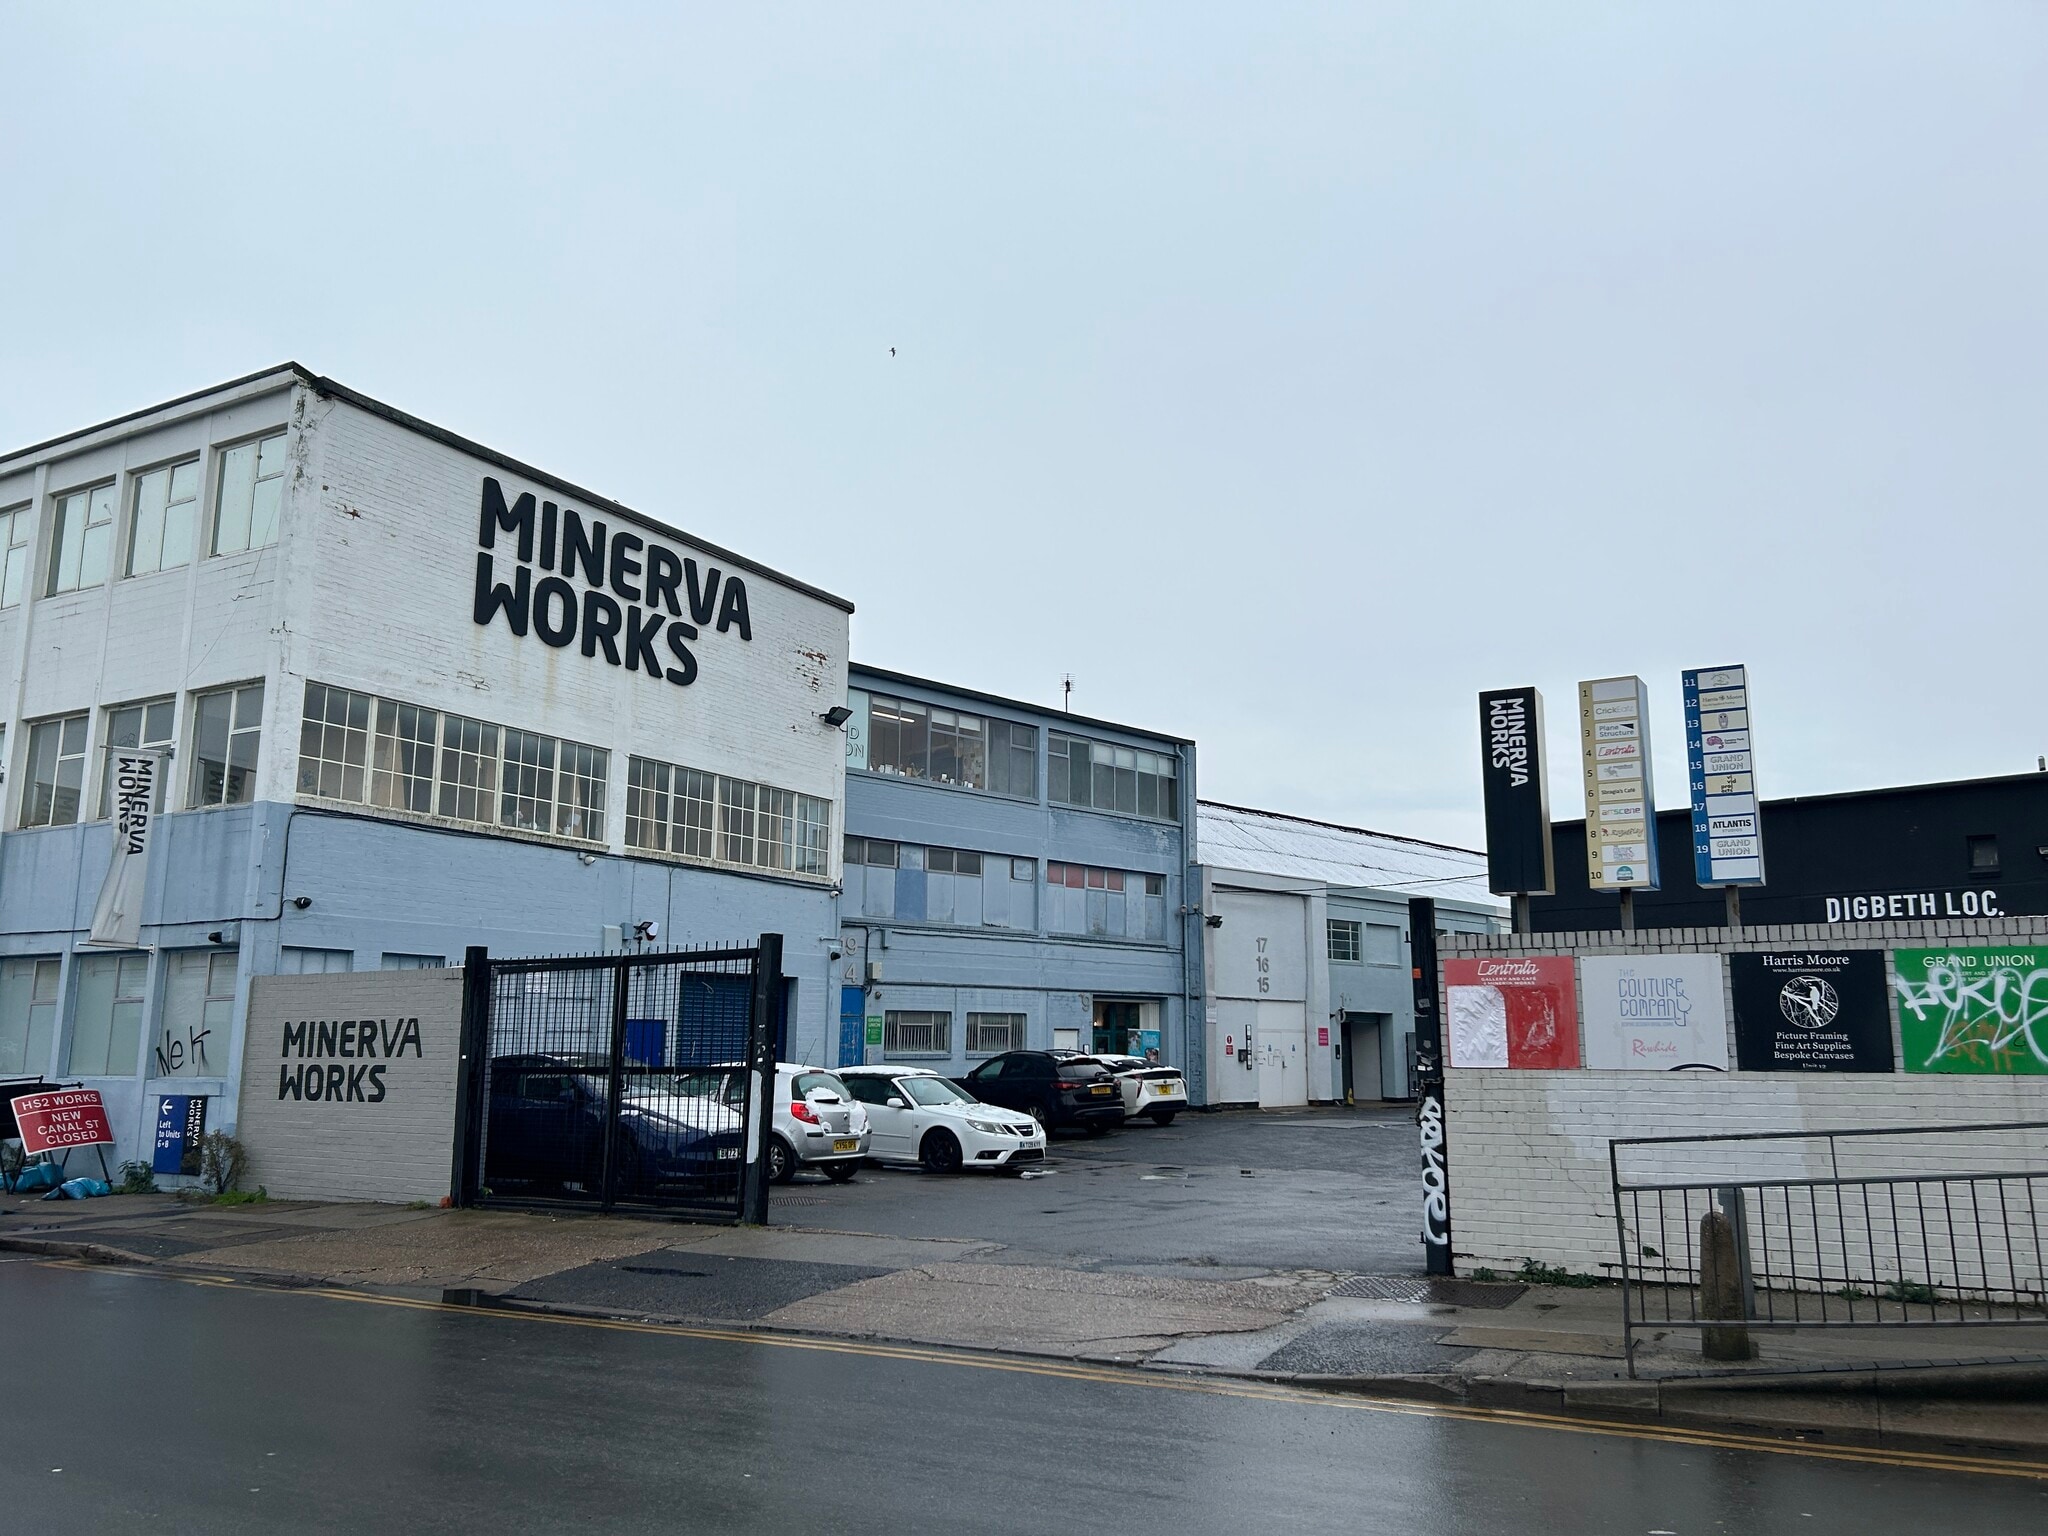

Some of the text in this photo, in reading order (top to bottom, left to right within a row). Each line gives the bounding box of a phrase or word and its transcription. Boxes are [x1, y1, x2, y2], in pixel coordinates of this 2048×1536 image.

[479, 476, 752, 640] MINERVA
[474, 551, 698, 685] WORKS
[1582, 690, 1588, 698] 1
[1686, 700, 1698, 708] 12
[1584, 710, 1590, 718] 2
[1687, 720, 1699, 728] 13
[1490, 700, 1510, 769] WORKS
[1585, 730, 1590, 738] 3
[1599, 730, 1635, 738] Structure
[1506, 698, 1529, 788] MINERVA
[1688, 741, 1701, 749] 14
[1690, 754, 1744, 770] 15 GRAND
[1712, 763, 1744, 772] UNION
[1587, 770, 1593, 778] 5
[1692, 782, 1704, 790] 16
[1588, 790, 1594, 798] 6
[127, 759, 154, 855] MINERVA
[1693, 802, 1705, 811] 17
[1589, 810, 1595, 818] 7
[1694, 819, 1752, 832] 18 ATLANTIS
[1590, 830, 1596, 838] 8
[1696, 839, 1751, 854] 19 GRAND
[1718, 848, 1751, 856] UNION
[1592, 850, 1598, 858] 9
[1591, 872, 1602, 880] 10
[1825, 890, 2005, 923] DIGBETH LOC.
[1256, 937, 1268, 953] 17
[1256, 956, 1269, 972] 16
[1762, 954, 1850, 966] Harris Moore
[1923, 954, 2035, 968] GRAND UNION
[1478, 960, 1540, 976] Centrala
[1257, 976, 1270, 994] 15
[1619, 978, 1687, 998] COUTURE
[1620, 999, 1692, 1024] COMPANY
[281, 1018, 423, 1058] MINERVA
[1776, 1032, 1849, 1042] Picture Framing
[1775, 1042, 1852, 1051] Fine Art Supplies
[1774, 1052, 1855, 1060] Bespoke Canvases
[278, 1064, 387, 1103] WORKS
[21, 1093, 98, 1111] HS2 WORKS
[51, 1110, 82, 1122] NEW
[186, 1099, 196, 1137] WORKS
[38, 1120, 100, 1136] CANAL ST
[159, 1120, 171, 1129] Left
[192, 1099, 202, 1148] MINERVA
[46, 1130, 98, 1145] CLOSED
[158, 1129, 181, 1139] to Units
